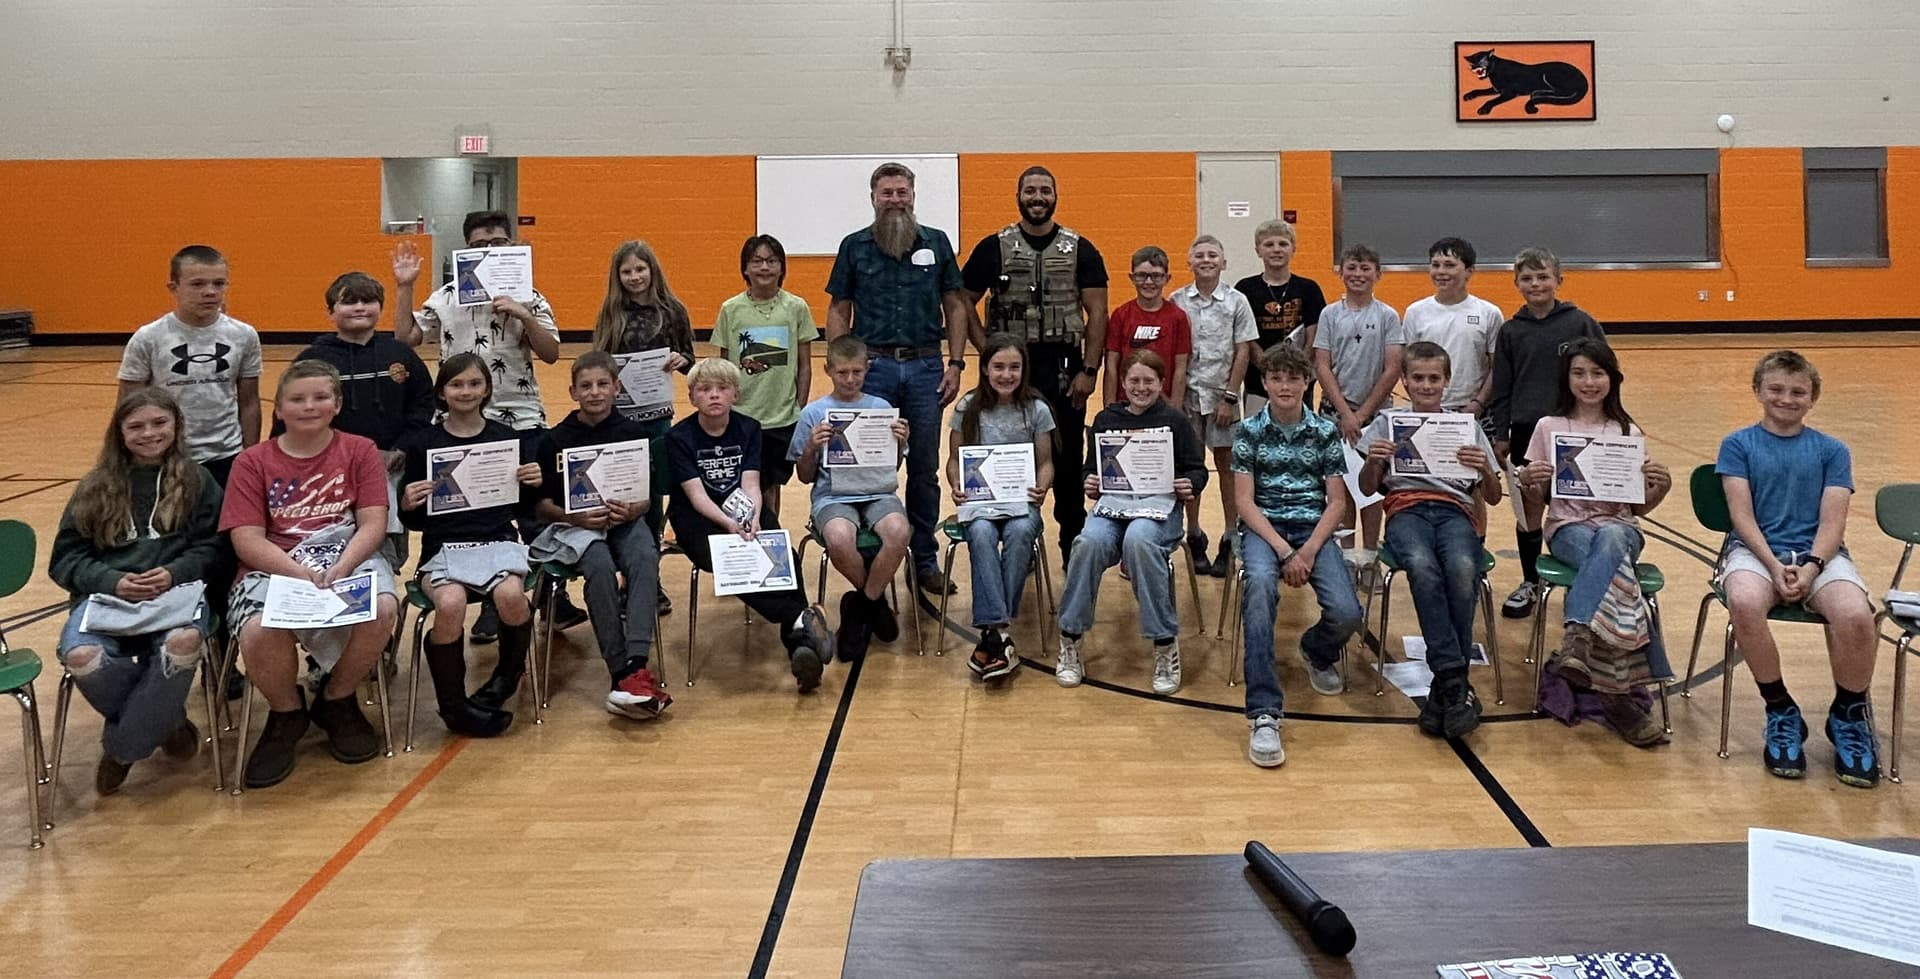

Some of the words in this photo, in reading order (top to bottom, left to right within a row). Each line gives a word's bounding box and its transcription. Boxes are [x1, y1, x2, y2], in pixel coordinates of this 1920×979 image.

[465, 137, 483, 151] EXIT
[1133, 325, 1161, 340] NIKE
[696, 454, 744, 470] PERFECT
[706, 467, 736, 479] GAME
[269, 505, 310, 518] SPEED
[311, 499, 351, 516] SHOP
